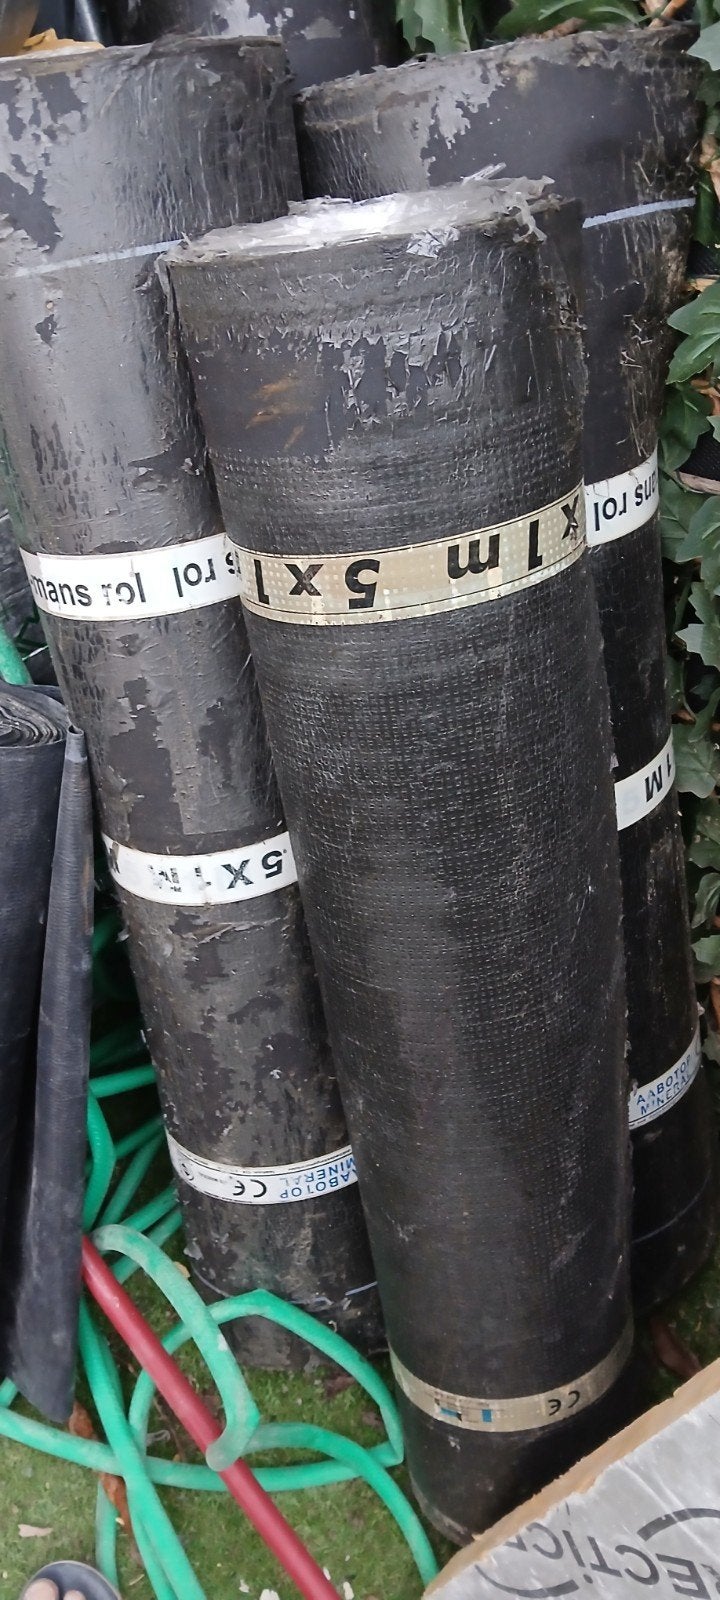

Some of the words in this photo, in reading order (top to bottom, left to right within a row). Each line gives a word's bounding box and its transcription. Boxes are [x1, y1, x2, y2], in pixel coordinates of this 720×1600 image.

[593, 491, 627, 532] rol
[447, 533, 500, 580] m
[527, 519, 543, 572] 1
[30, 574, 93, 607] mans
[172, 557, 217, 598] rol
[253, 558, 270, 606] 1
[283, 563, 323, 597] x
[344, 558, 381, 610] 5
[644, 765, 663, 803] M
[220, 858, 254, 890] X
